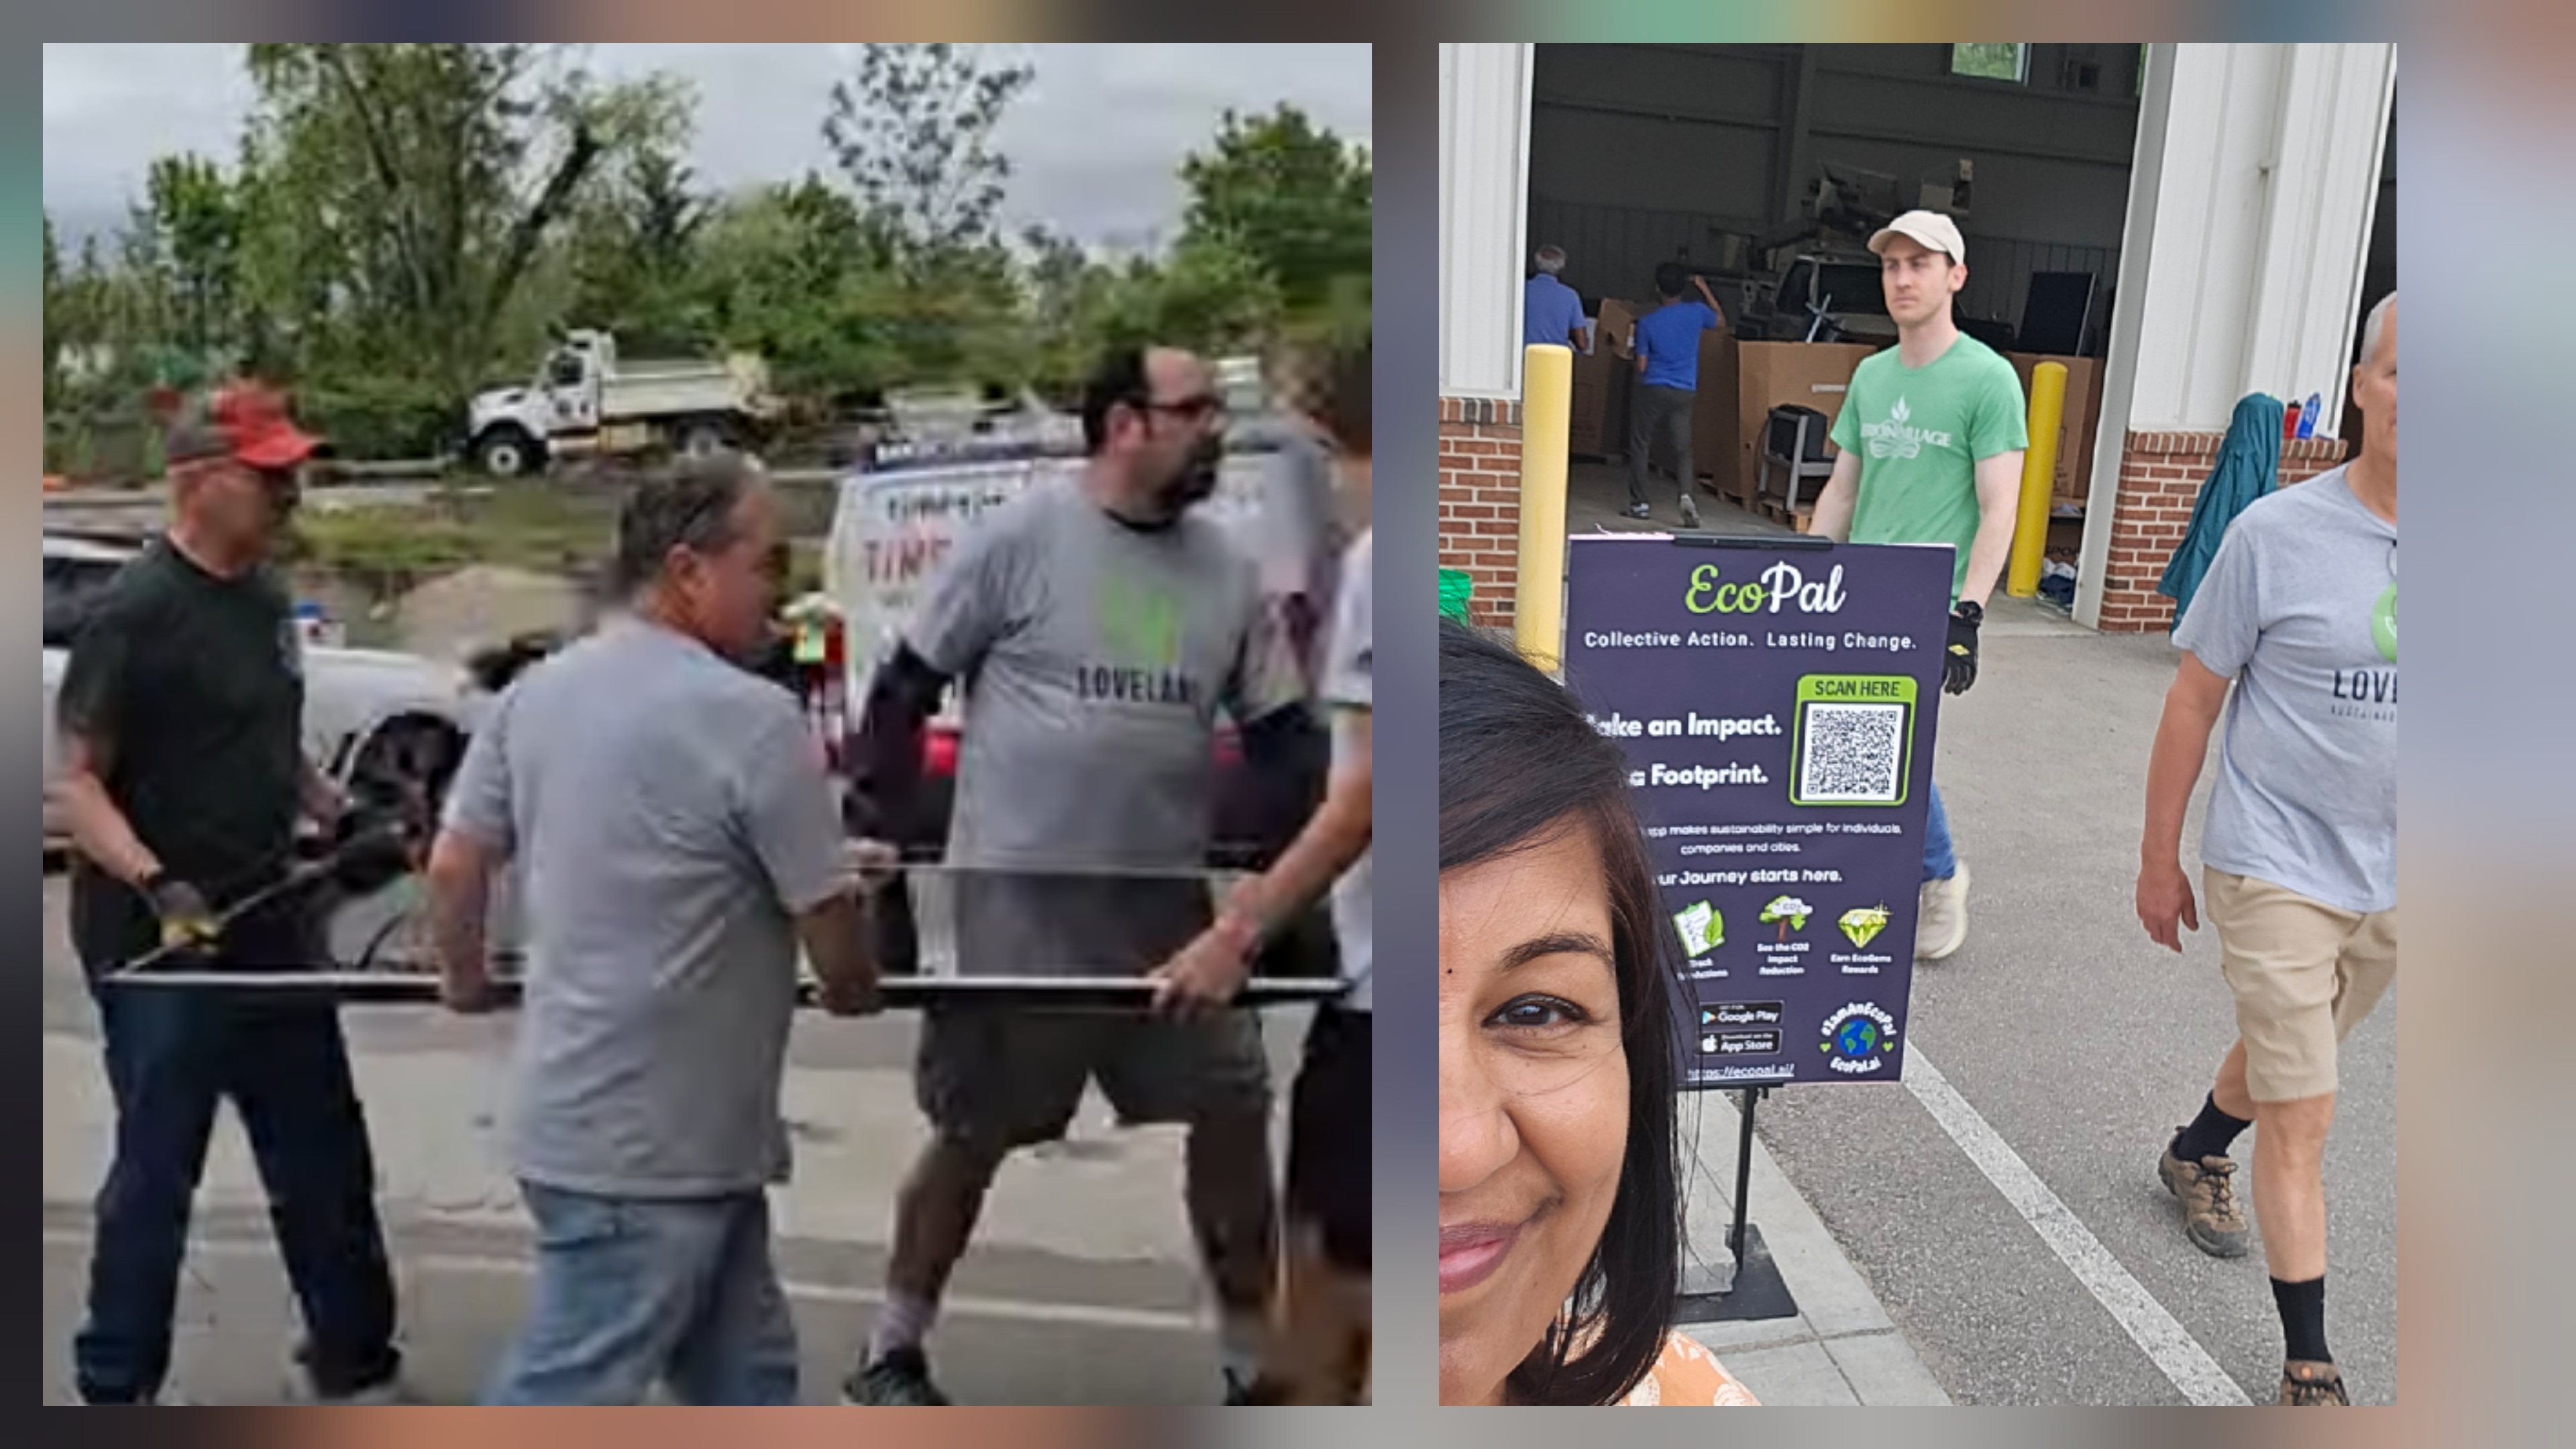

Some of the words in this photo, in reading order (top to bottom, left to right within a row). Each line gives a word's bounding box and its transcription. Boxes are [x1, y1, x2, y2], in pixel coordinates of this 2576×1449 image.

[1685, 559, 1847, 613] EcoPal
[1585, 631, 1680, 648] Collective
[1687, 630, 1755, 647] Action.
[1767, 631, 1835, 651] Lasting
[1843, 632, 1917, 652] Change.
[1815, 680, 1856, 696] SCAN
[1860, 682, 1900, 696] HERE
[1585, 712, 1643, 737] ake
[1648, 718, 1682, 736] an
[1688, 712, 1782, 741] Impact.
[1652, 761, 1769, 790] Footprint.
[1670, 825, 1708, 835] makes
[1710, 824, 1784, 835] sustainability
[1786, 823, 1824, 835] simple
[1826, 822, 1841, 834] for
[1842, 823, 1902, 835] individuals,
[1680, 843, 1743, 855] companies
[1746, 842, 1768, 853] and
[1770, 841, 1802, 852] cities.
[1679, 871, 1747, 885] Journey
[1750, 869, 1799, 883] starts
[1803, 869, 1843, 883] here.
[1767, 955, 1798, 965] Impact
[1758, 967, 1805, 975] Reduction
[1841, 965, 1879, 974] Rewards
[1717, 1011, 1755, 1023] Google
[1756, 1010, 1779, 1023] Play
[1721, 1041, 1743, 1053] App
[1745, 1040, 1773, 1051] Store
